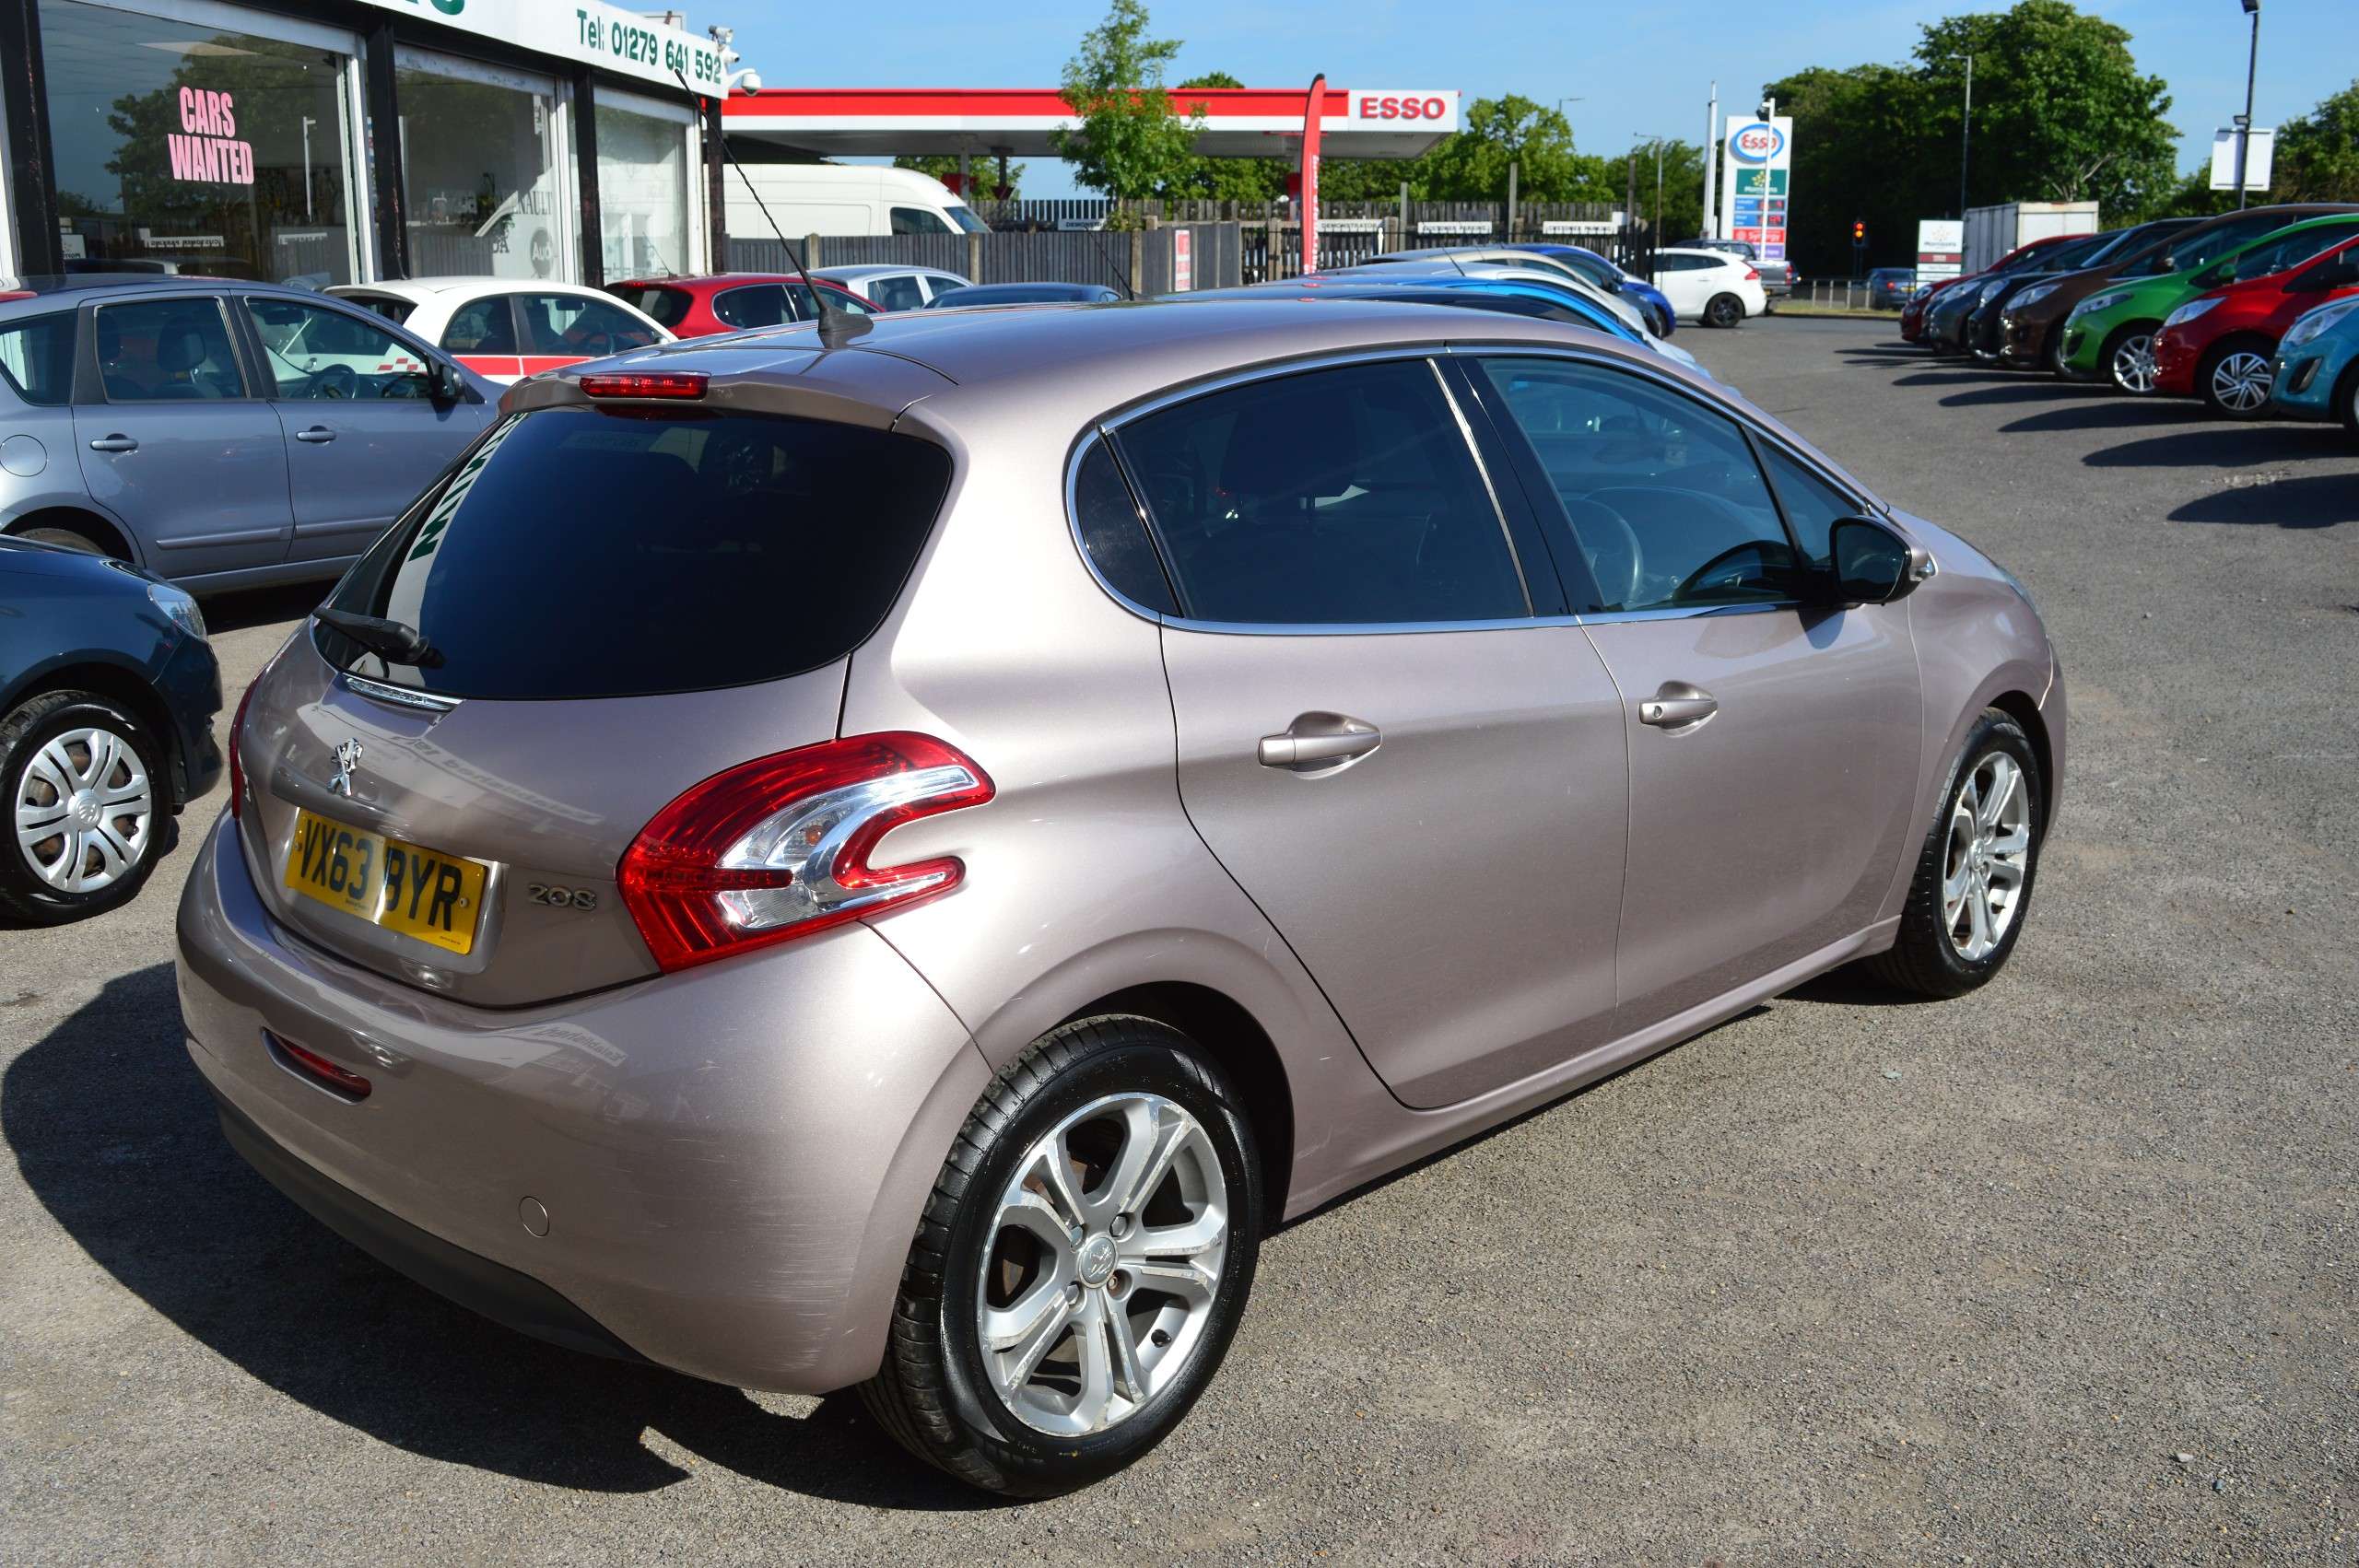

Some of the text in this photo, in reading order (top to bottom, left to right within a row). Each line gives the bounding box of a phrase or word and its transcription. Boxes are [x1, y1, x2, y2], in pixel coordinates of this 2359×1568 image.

[576, 8, 722, 85] Tel: 01279 641 592
[180, 87, 235, 137] CARS
[1359, 97, 1446, 120] ESSO
[168, 134, 254, 184] WANTED
[299, 818, 464, 933] VX63 BYR
[527, 883, 598, 911] 208
